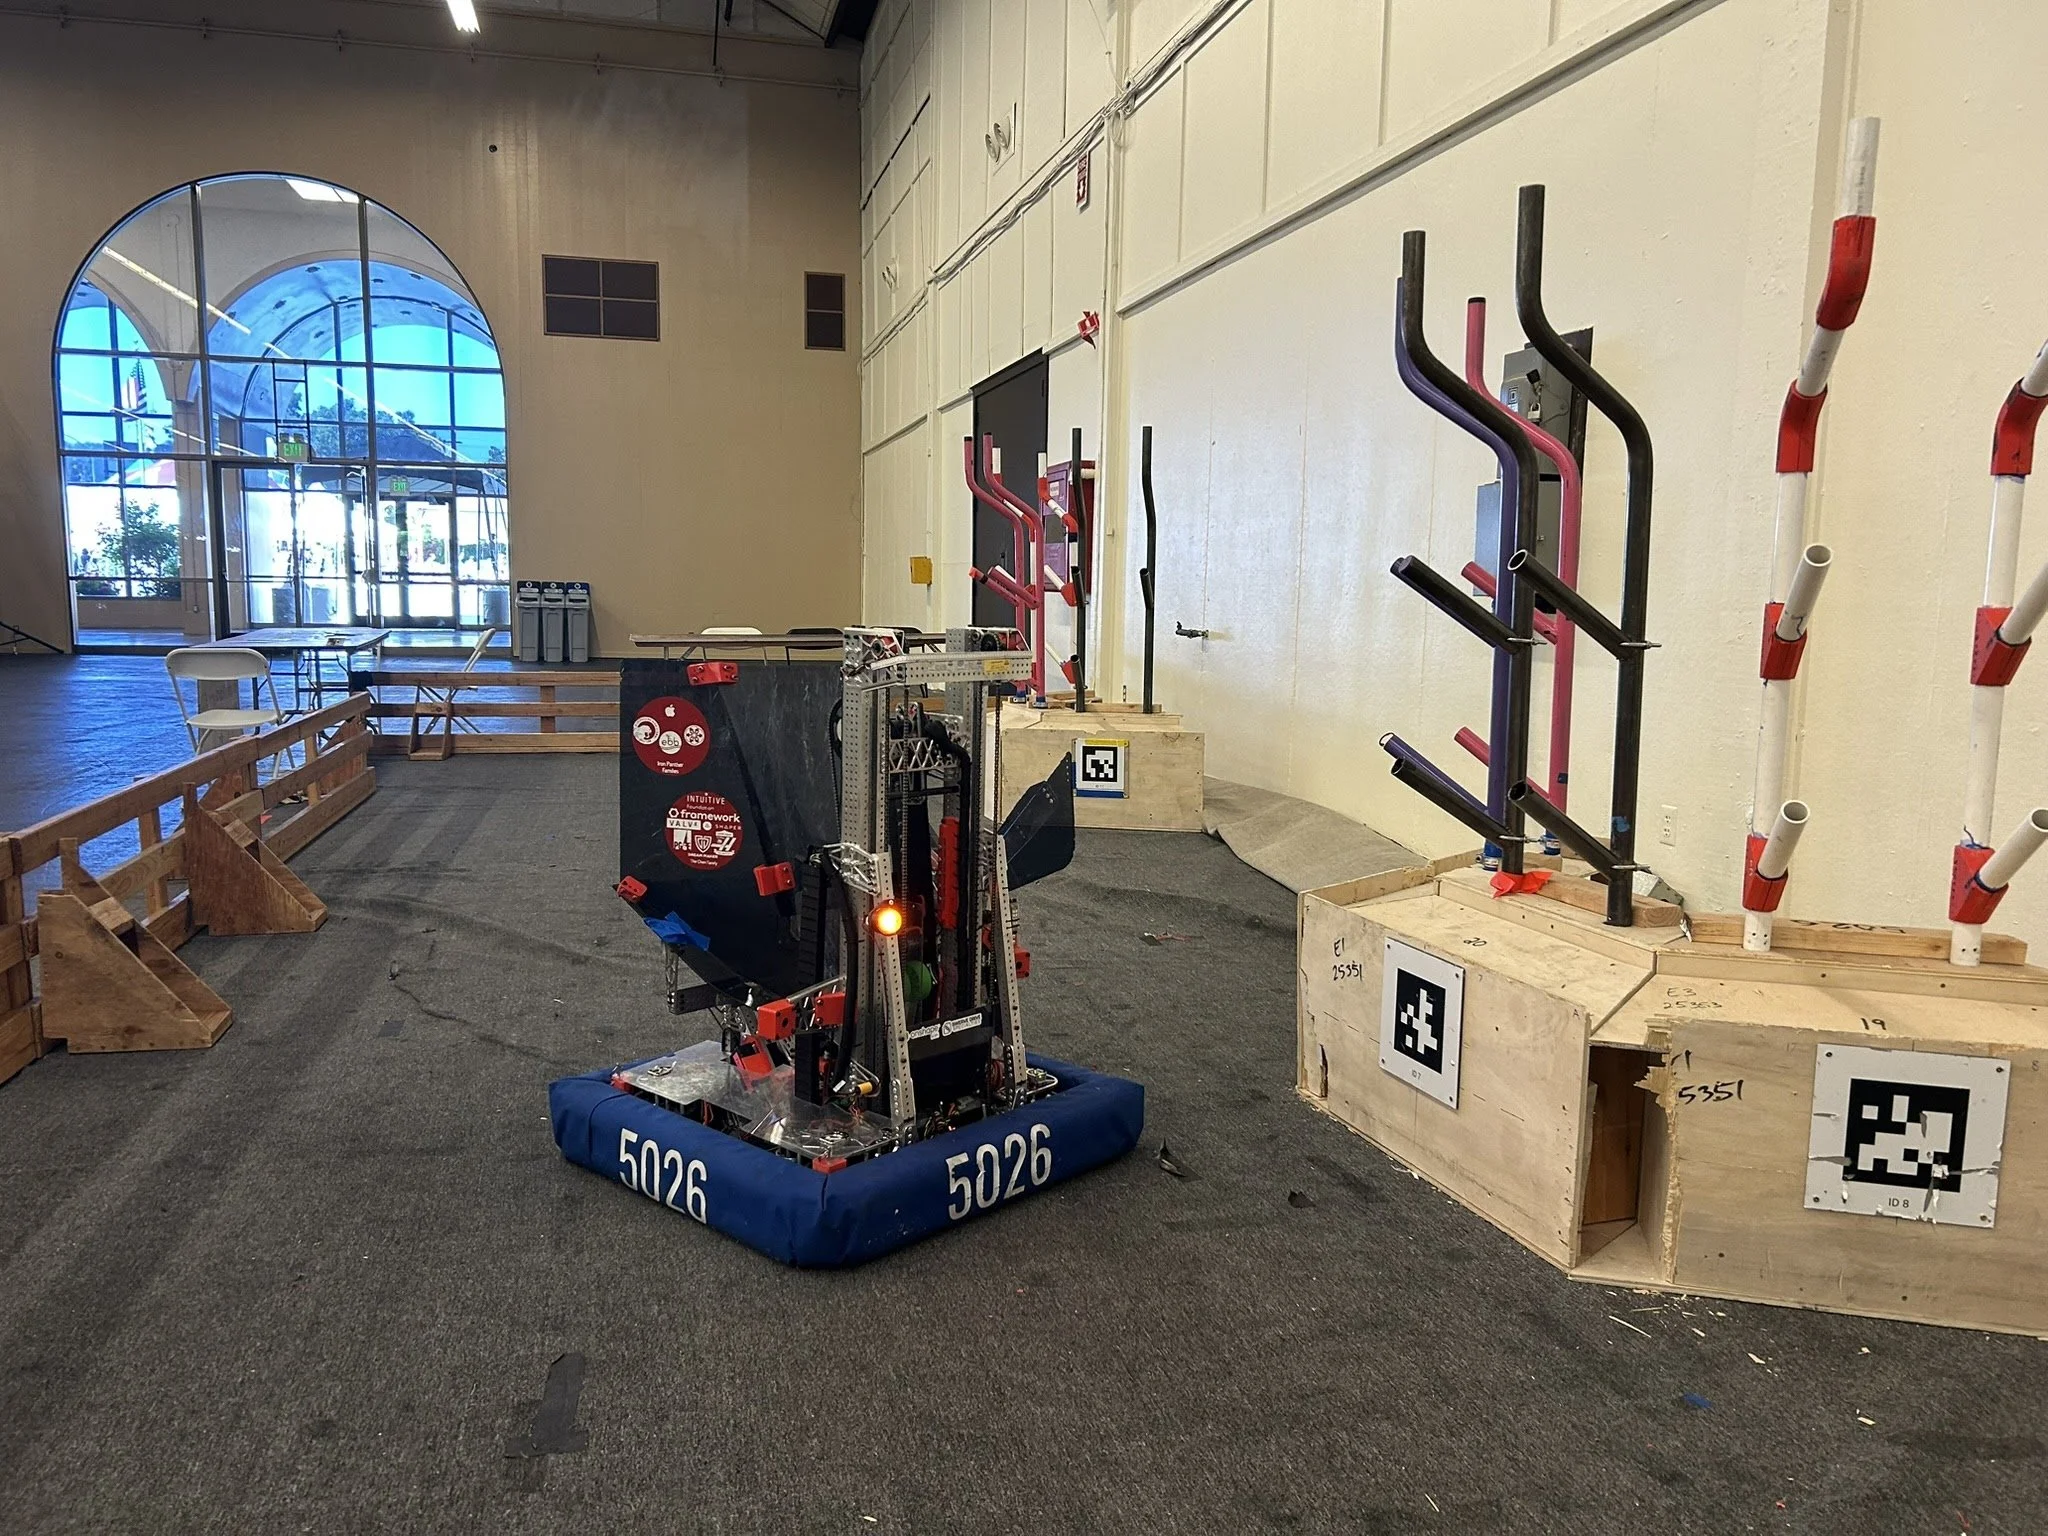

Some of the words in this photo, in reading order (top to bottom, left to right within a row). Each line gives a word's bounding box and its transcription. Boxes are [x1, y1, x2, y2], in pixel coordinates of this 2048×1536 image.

[283, 443, 304, 457] EXIT
[393, 482, 406, 492] EXIT
[661, 734, 680, 747] ebb
[686, 793, 726, 805] INTUITIVE
[680, 809, 741, 823] framework
[715, 823, 742, 831] SHAPER
[1332, 963, 1363, 981] 25351
[1860, 1017, 1887, 1031] 19
[910, 1026, 939, 1038] onshape
[619, 1127, 708, 1225] 5026
[945, 1123, 1052, 1221] 5026
[1888, 1197, 1900, 1207] ID
[1902, 1199, 1910, 1208] 8
